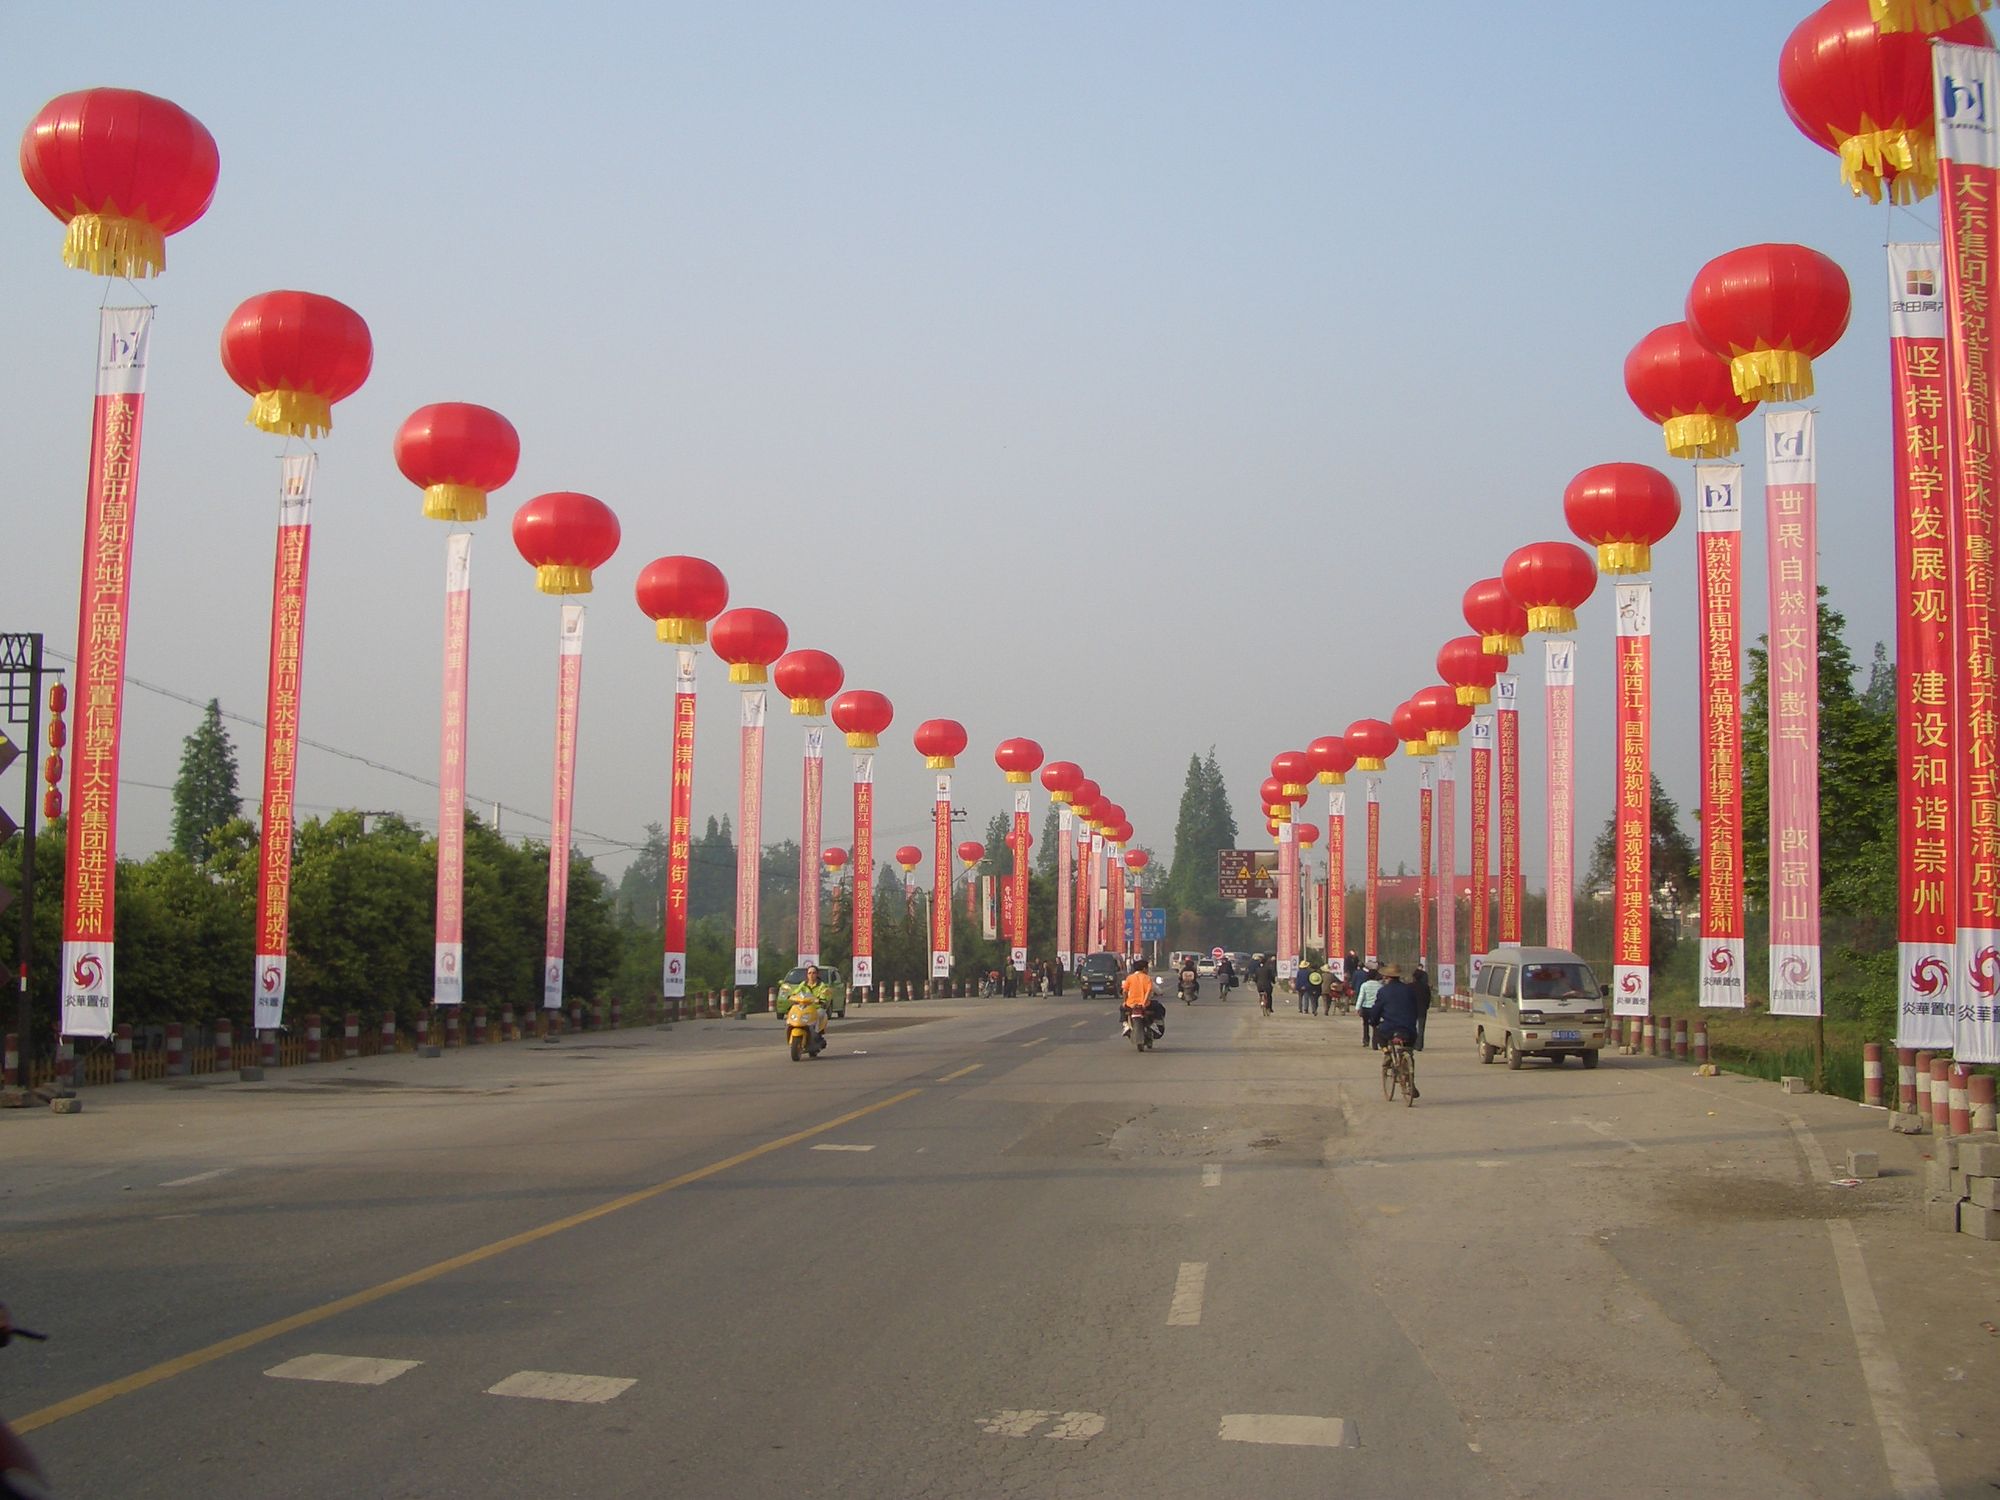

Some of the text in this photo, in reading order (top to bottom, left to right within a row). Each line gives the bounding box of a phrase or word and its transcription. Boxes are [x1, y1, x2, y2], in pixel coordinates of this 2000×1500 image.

[75, 400, 134, 935] 热烈欢迎中国知名地产品牌炎华置信携手大东集团进驻崇州
[1707, 537, 1734, 933] 热烈欢迎中国知名地产品牌炎华置信携手大东集团进驻崇州
[1906, 345, 1950, 935] 坚持科学发展观，建设和谐崇州。
